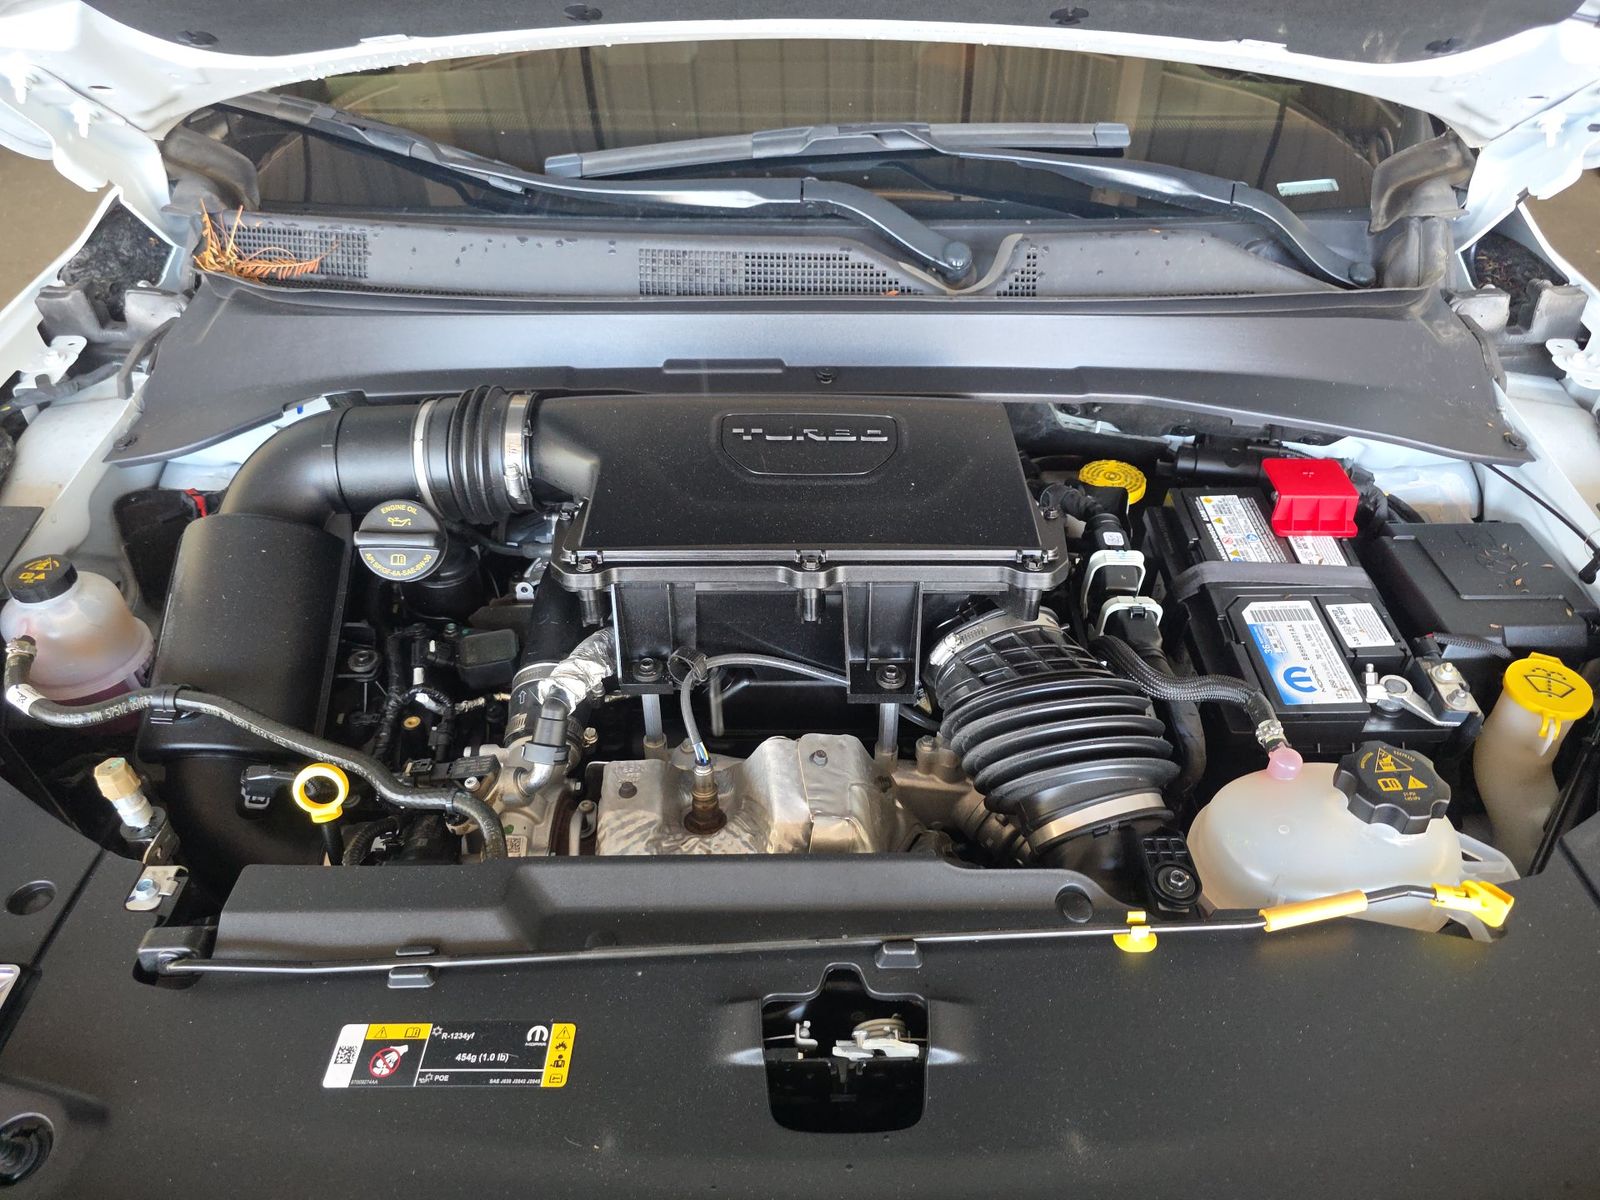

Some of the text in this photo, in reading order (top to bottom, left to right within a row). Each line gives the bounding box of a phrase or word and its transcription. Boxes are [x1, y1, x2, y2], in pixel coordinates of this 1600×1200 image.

[732, 428, 888, 442] TURBO
[380, 504, 418, 515] ENGINE OIL
[1261, 643, 1273, 654] 36
[1308, 664, 1327, 692] MOPAR
[441, 1032, 475, 1041] R-1234yf
[455, 1053, 509, 1063] 454g (1.0 lb)
[434, 1074, 449, 1082] POE
